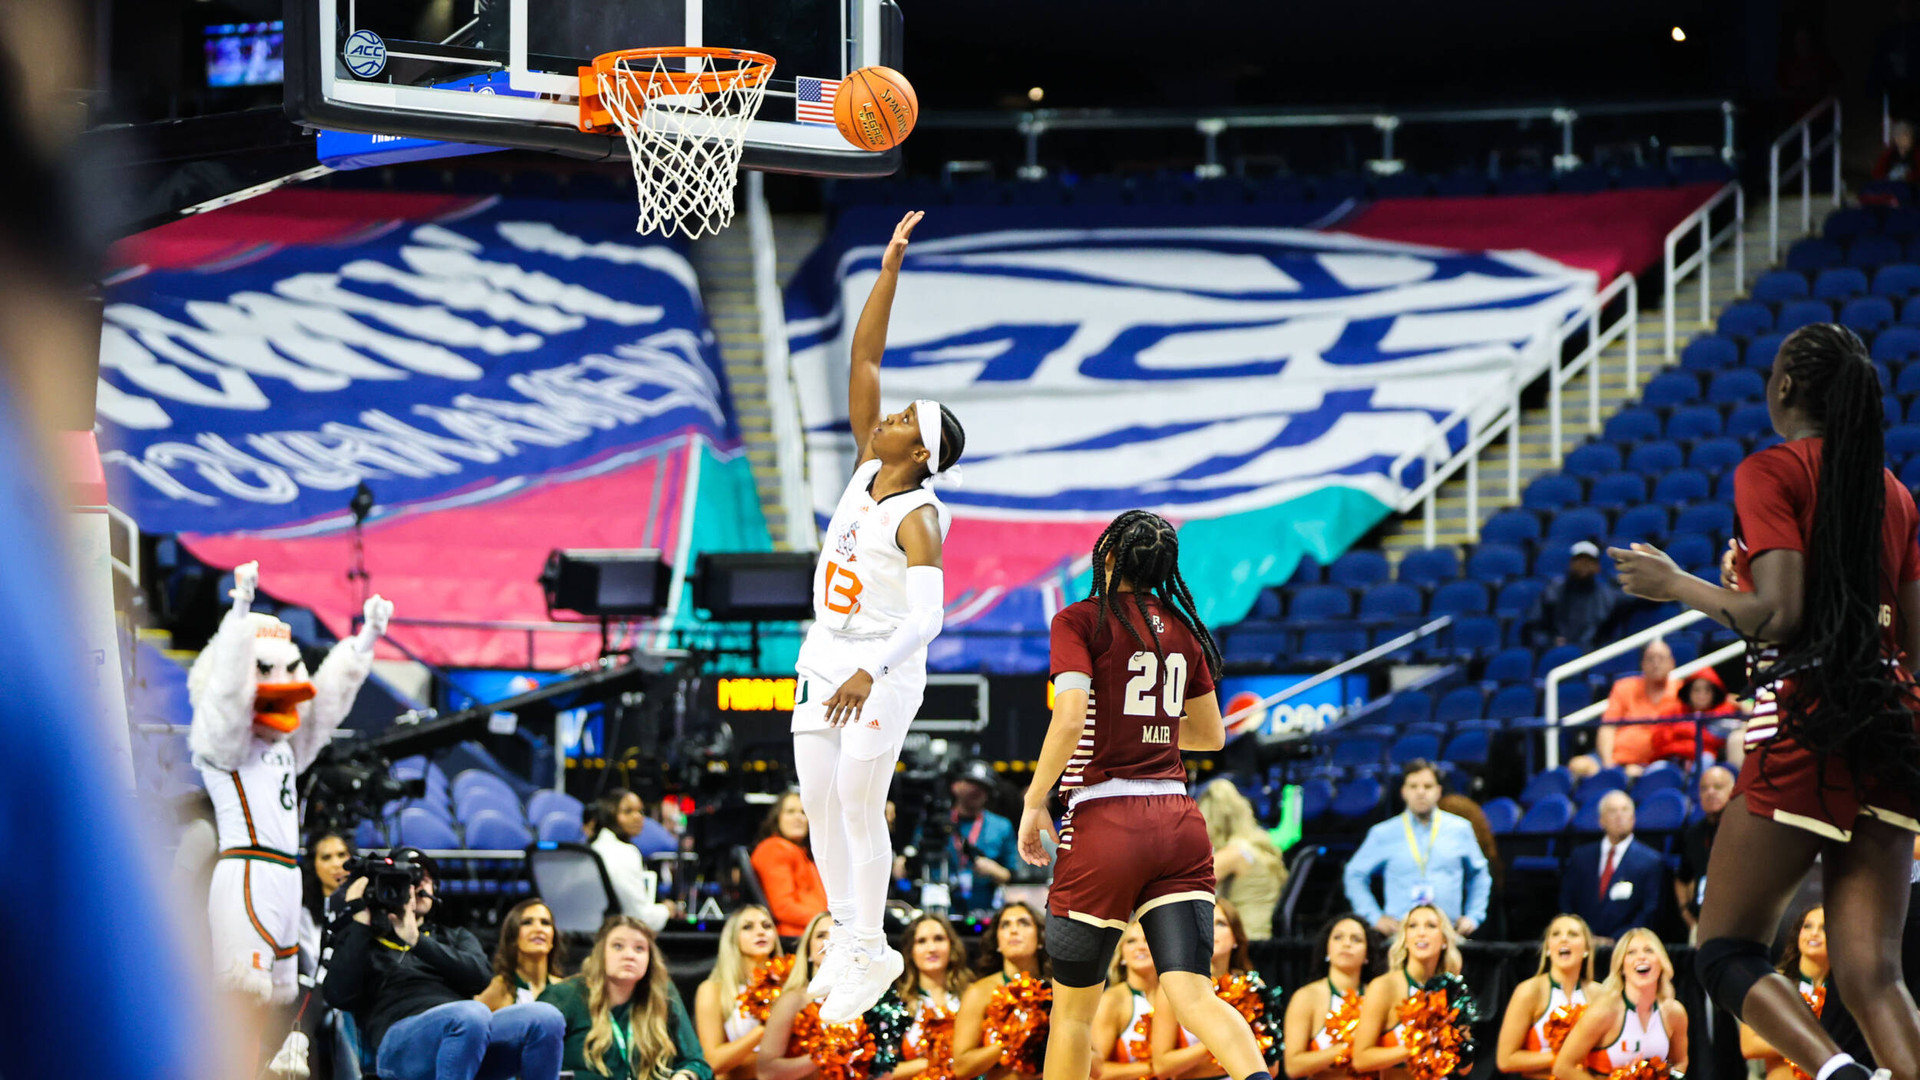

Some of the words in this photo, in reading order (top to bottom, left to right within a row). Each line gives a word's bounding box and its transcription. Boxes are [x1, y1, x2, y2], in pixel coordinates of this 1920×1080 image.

[350, 44, 384, 57] ACC
[862, 102, 886, 146] LEGACY
[880, 88, 909, 140] SPALDING
[824, 560, 864, 615] 13
[1122, 650, 1188, 718] 20
[1141, 724, 1171, 744] MAIR
[280, 772, 294, 811] 6
